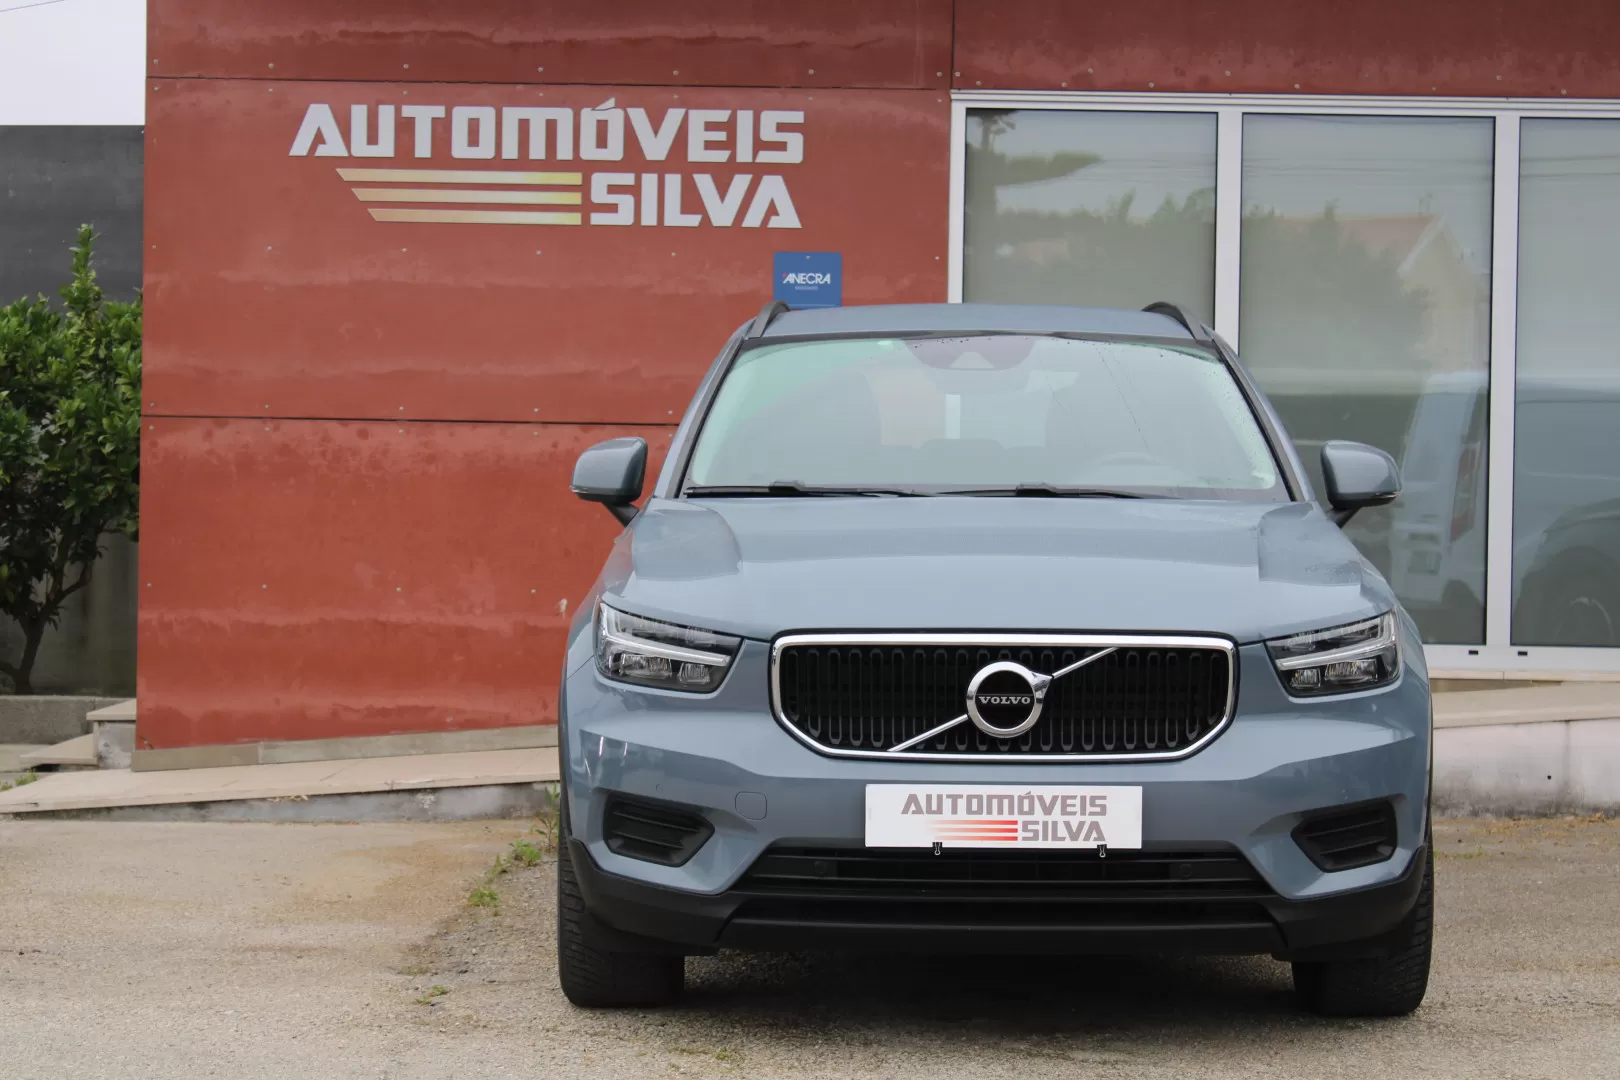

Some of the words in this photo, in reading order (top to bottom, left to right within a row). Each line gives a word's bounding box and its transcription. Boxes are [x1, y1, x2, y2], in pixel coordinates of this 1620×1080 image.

[289, 97, 805, 164] AUTOMÓVEIS
[590, 172, 803, 228] SILVA
[782, 272, 832, 285] ANECRA
[978, 696, 1031, 705] VOLVO
[901, 791, 1107, 817] AUTOMÓVEIS
[1021, 820, 1106, 842] SILVA
